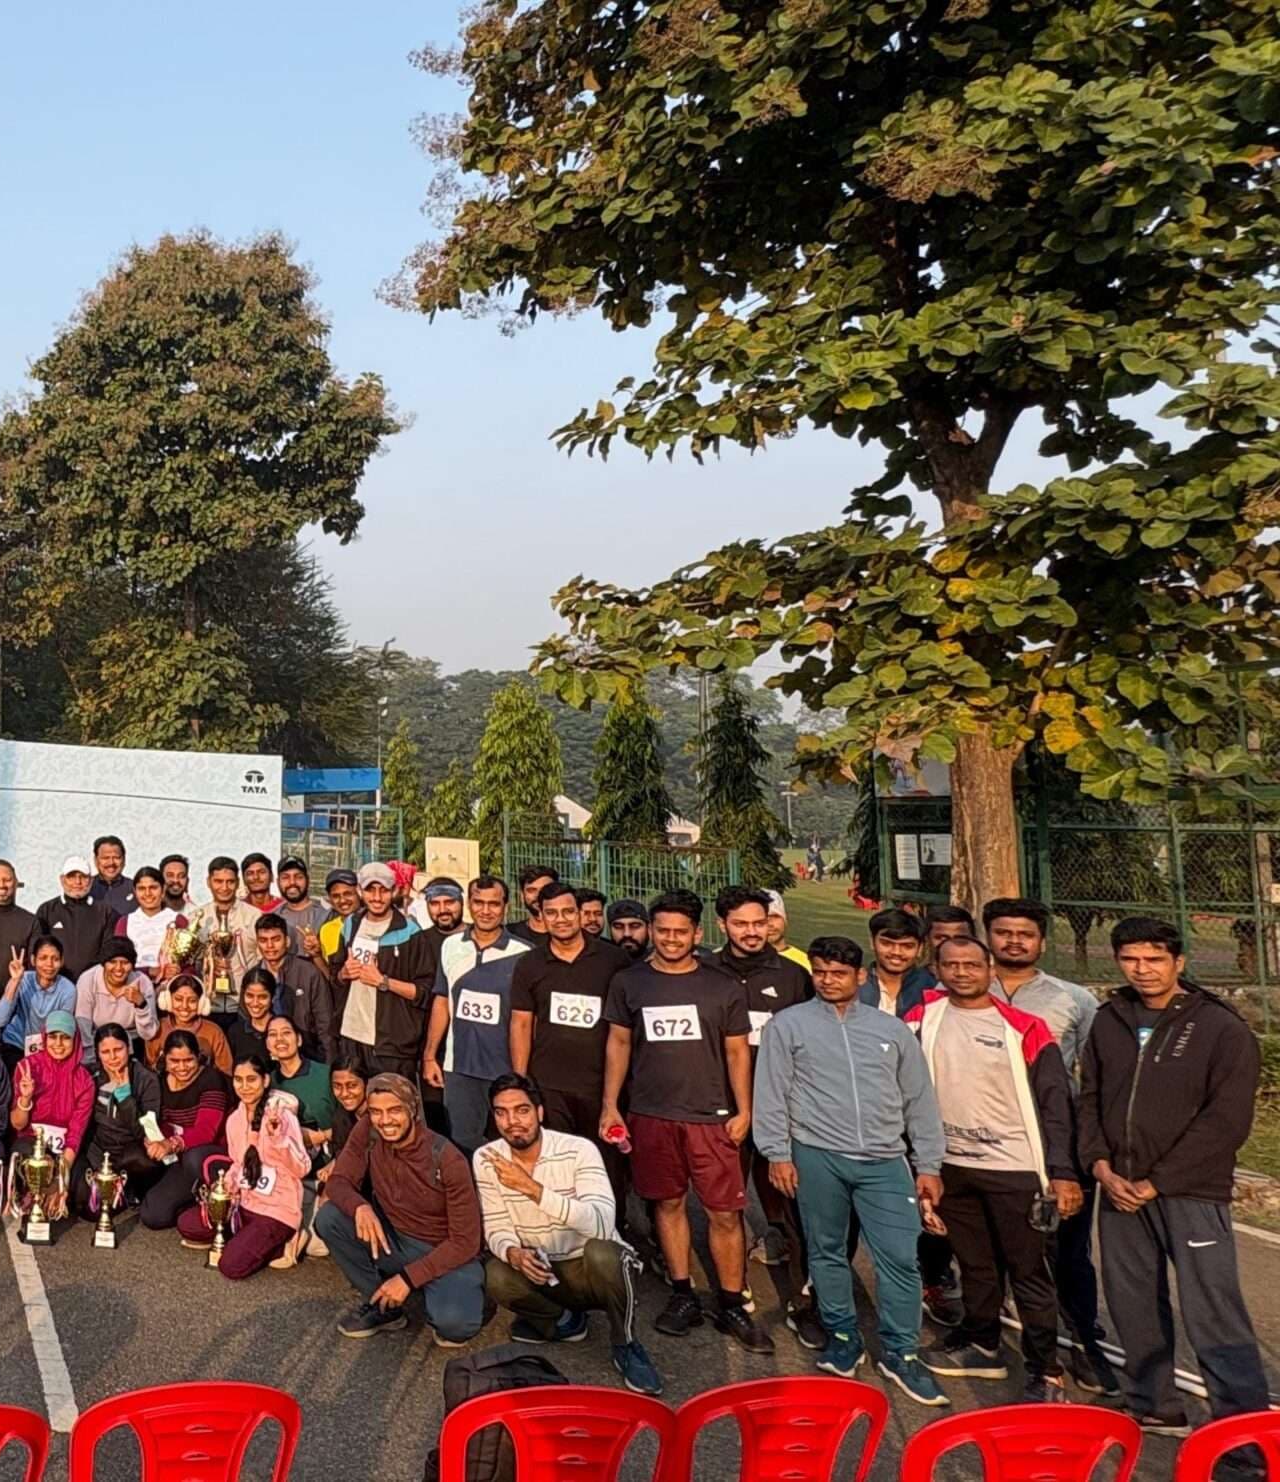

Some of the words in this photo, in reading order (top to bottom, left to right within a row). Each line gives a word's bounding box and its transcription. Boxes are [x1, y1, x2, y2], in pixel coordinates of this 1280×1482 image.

[241, 785, 268, 794] TATA
[461, 1001, 494, 1021] 633
[557, 1005, 595, 1025] 626
[652, 1018, 695, 1037] 672
